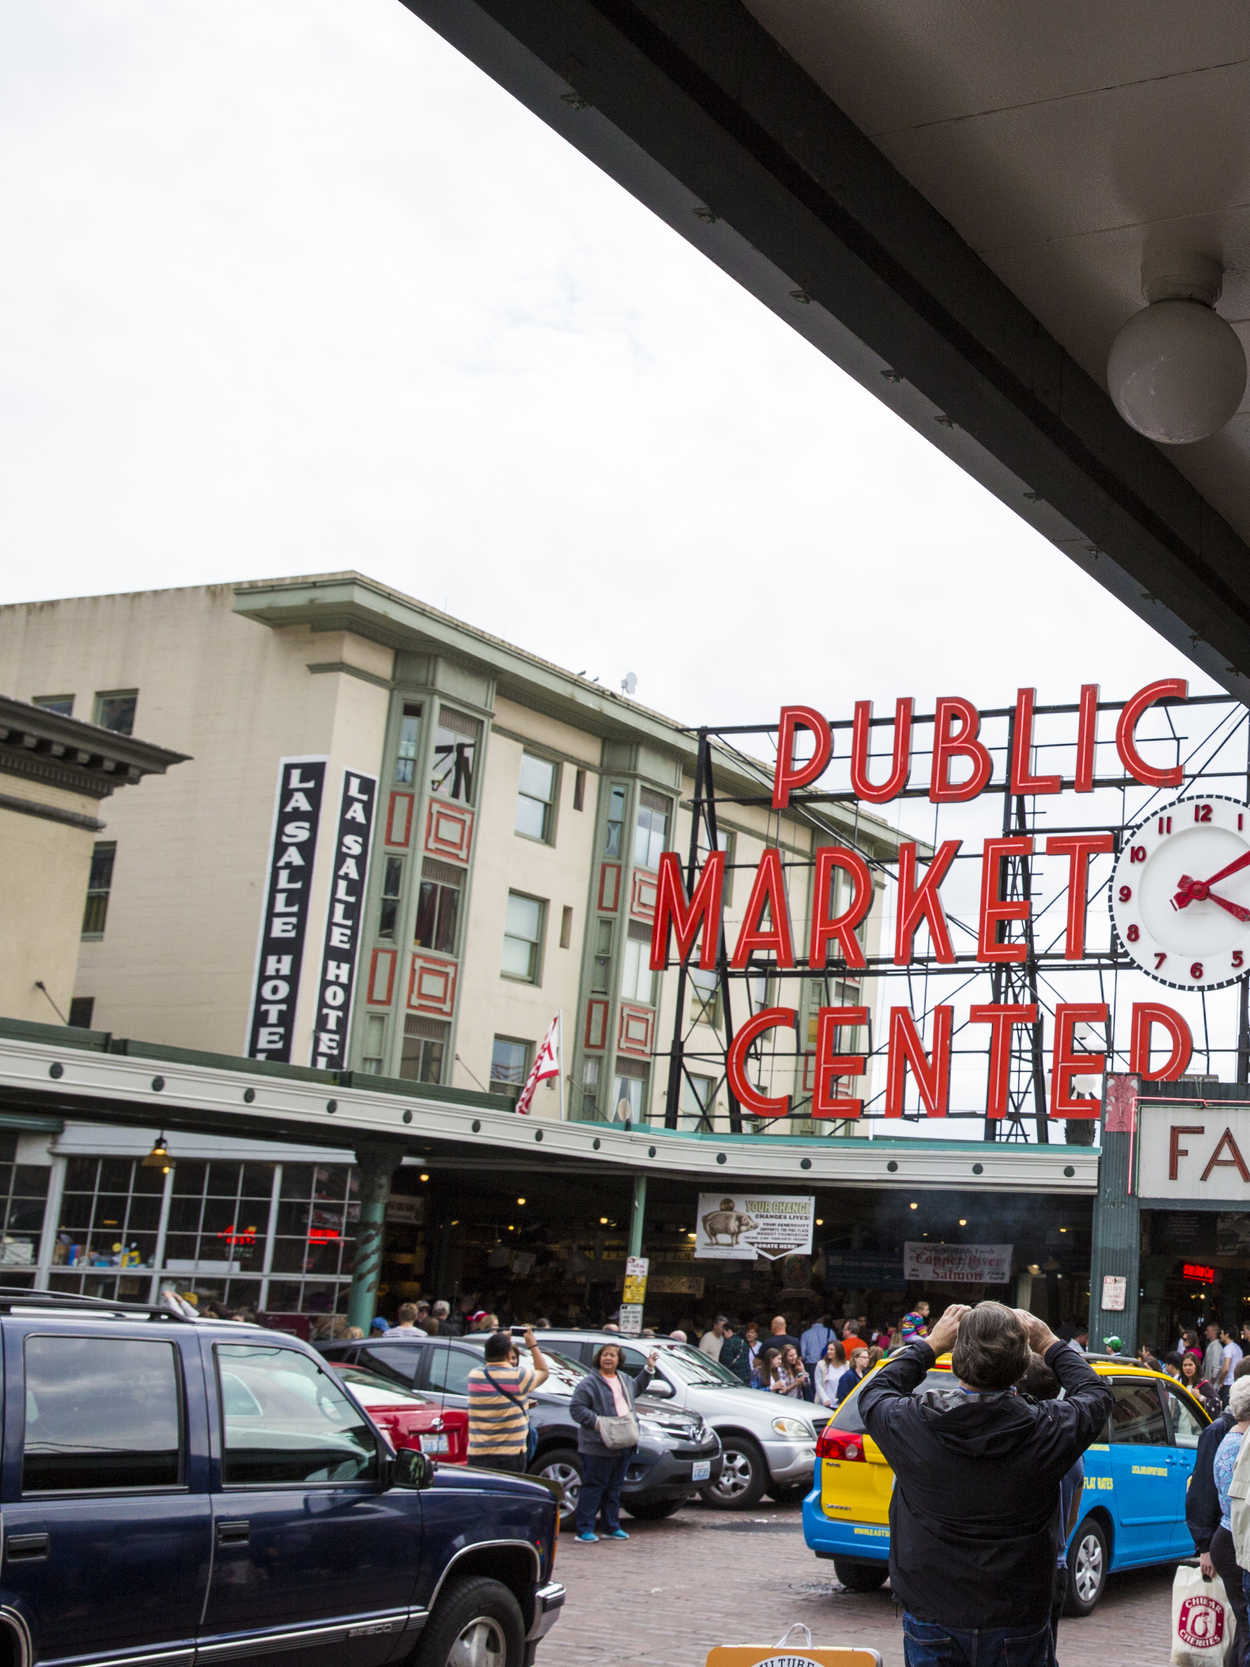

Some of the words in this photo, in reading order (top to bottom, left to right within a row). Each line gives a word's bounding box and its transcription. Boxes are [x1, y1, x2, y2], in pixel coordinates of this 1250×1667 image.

[772, 678, 1188, 808] PUBLIC
[283, 767, 315, 812] LA
[344, 776, 368, 825] LA
[1194, 804, 1213, 822] 12
[1237, 813, 1244, 831] 1
[1158, 816, 1172, 835] 11
[1130, 846, 1147, 863] 10
[270, 820, 311, 938] SALLE
[329, 834, 363, 950] SALLE
[1118, 885, 1132, 903] 9
[650, 834, 1114, 970] MARKET
[1126, 924, 1140, 942] 8
[1154, 952, 1167, 970] 7
[1230, 950, 1244, 968] 5
[1190, 962, 1203, 979] 6
[745, 1200, 771, 1213] YOUR
[772, 1201, 811, 1214] CHANGE
[915, 1252, 962, 1268] Copper
[967, 1254, 1003, 1267] River
[932, 1268, 983, 1281] Salmon
[1083, 1477, 1097, 1490] FLAT
[1097, 1477, 1114, 1490] RATES
[1185, 1597, 1223, 1614] CHUKAR
[1179, 1629, 1221, 1647] CHERRIES
